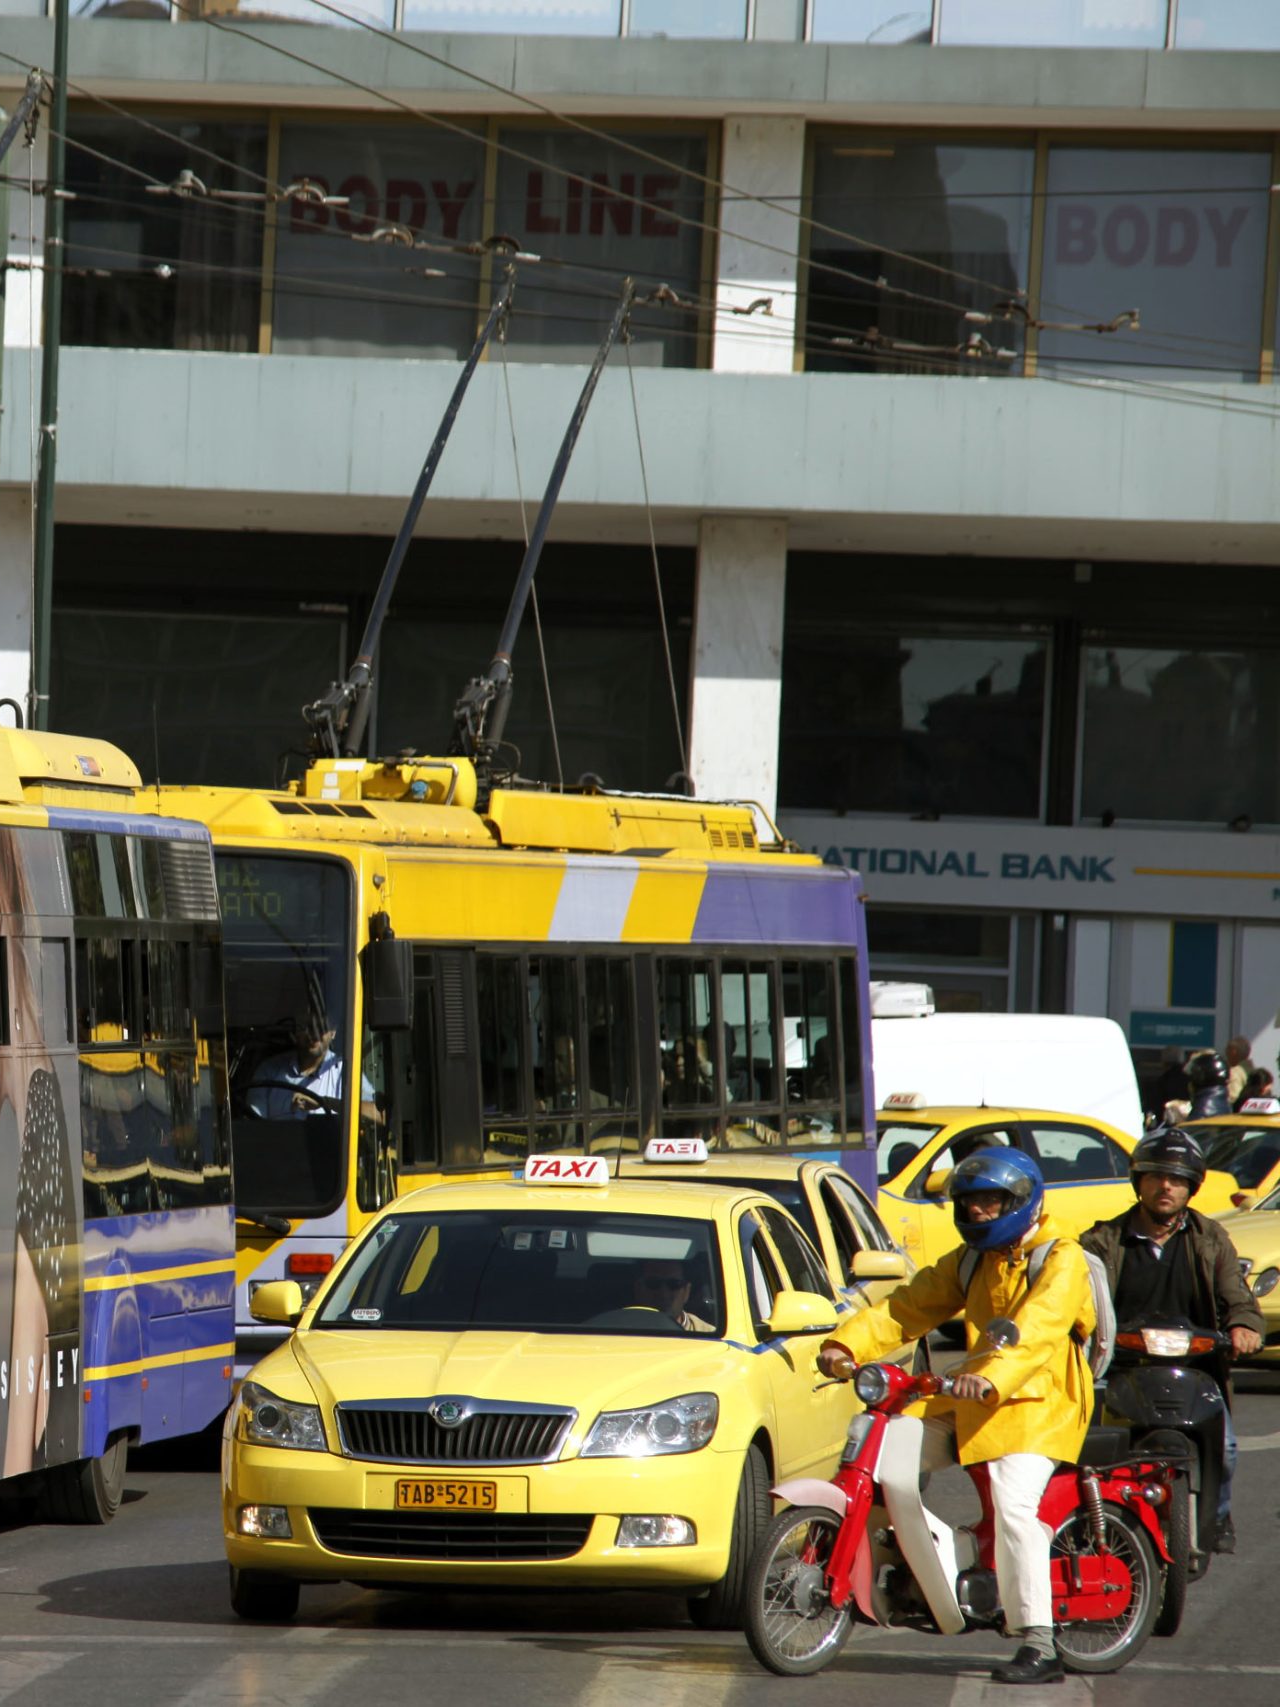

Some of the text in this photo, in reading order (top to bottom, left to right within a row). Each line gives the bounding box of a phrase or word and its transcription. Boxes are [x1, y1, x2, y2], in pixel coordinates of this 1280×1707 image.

[289, 171, 681, 240] BODY LINE
[1055, 204, 1252, 268] BODY
[812, 846, 1116, 883] ATIONAL BANK
[530, 1160, 598, 1178] TAXI
[0, 1348, 79, 1400] SISLEY
